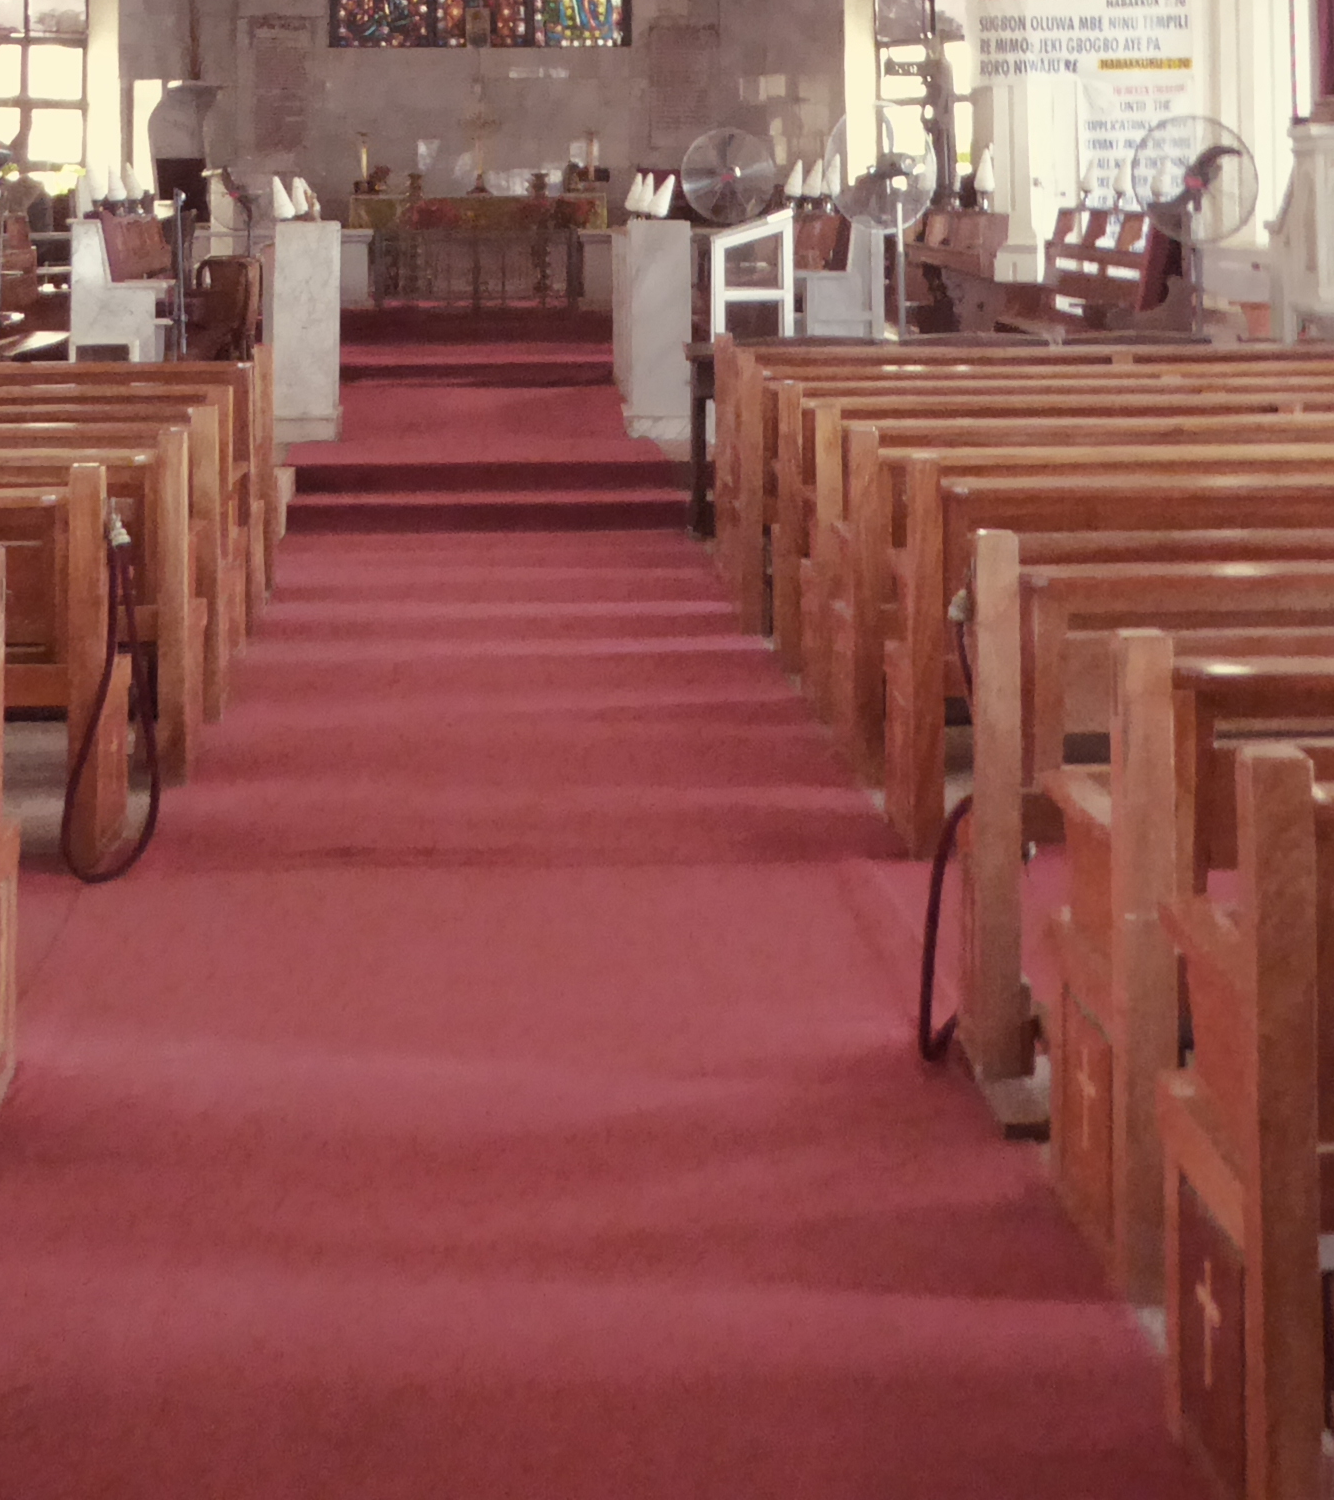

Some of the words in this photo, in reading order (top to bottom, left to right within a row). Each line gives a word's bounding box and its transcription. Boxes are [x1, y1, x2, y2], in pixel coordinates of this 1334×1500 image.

[1030, 15, 1075, 31] OLUWA
[1108, 15, 1139, 31] NINU
[1143, 13, 1189, 30] TEMPILI
[1065, 36, 1120, 55] GBOGBO
[1123, 36, 1143, 53] AYE
[1146, 36, 1161, 53] PA
